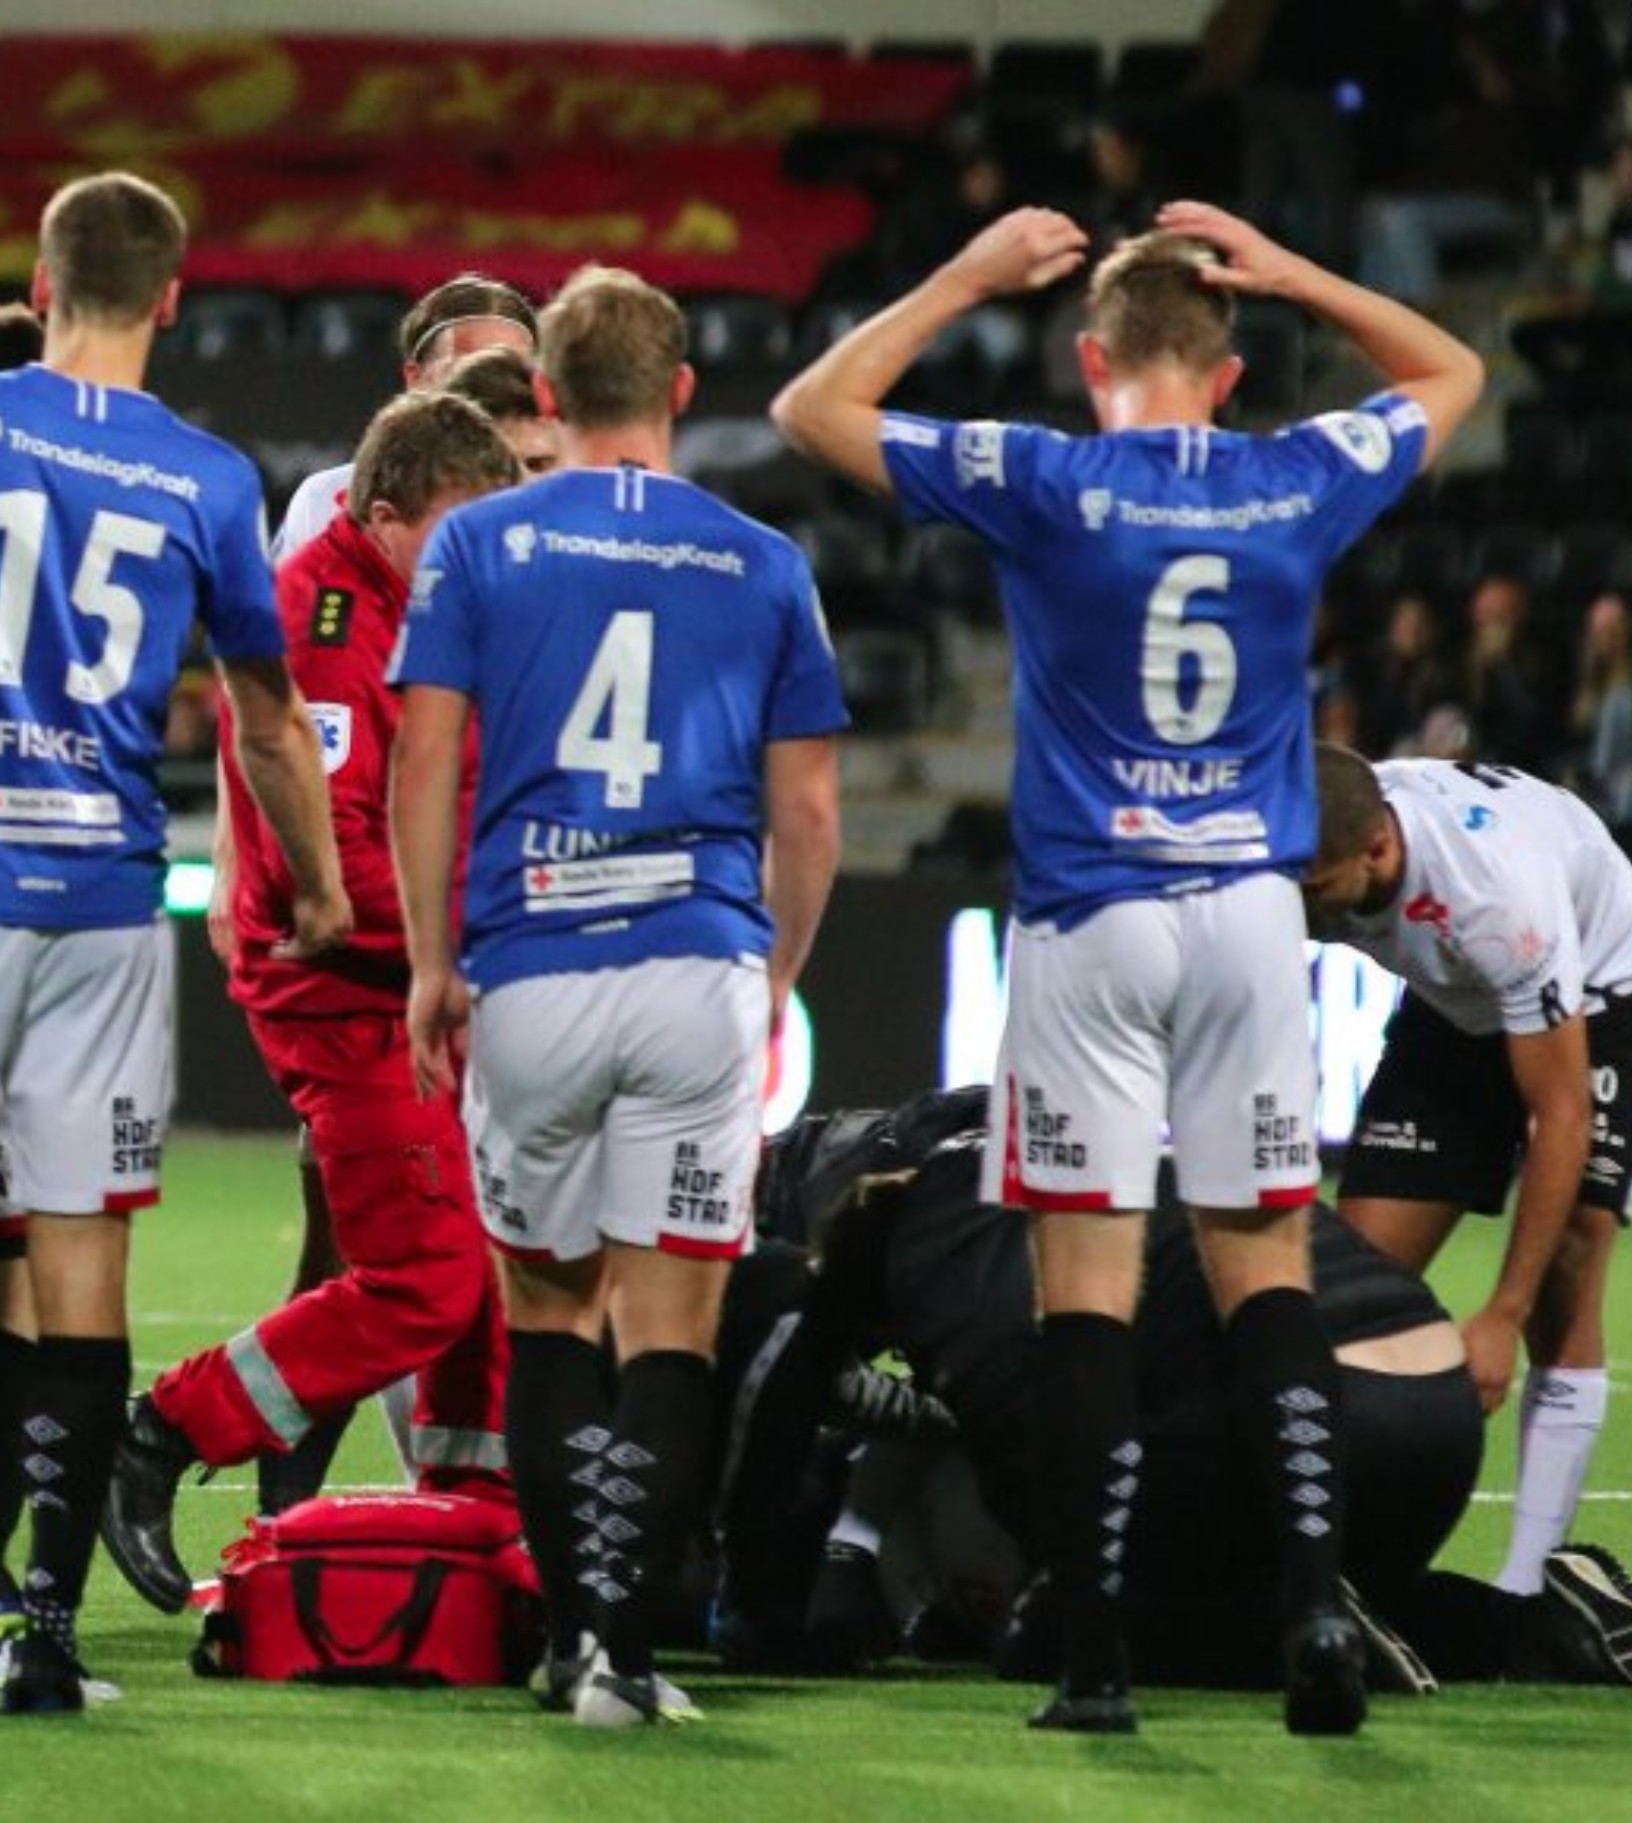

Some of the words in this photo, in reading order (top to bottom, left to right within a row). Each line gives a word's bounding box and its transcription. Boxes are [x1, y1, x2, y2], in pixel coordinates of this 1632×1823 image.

[1142, 554, 1237, 744] 6
[555, 610, 662, 808] 4
[1112, 758, 1246, 798] VINJE
[113, 1119, 156, 1146] HOF
[1027, 1111, 1072, 1137] HOF
[1254, 1115, 1300, 1142] HOF
[113, 1146, 162, 1174] STA
[1027, 1139, 1086, 1170] STAD
[672, 1167, 723, 1194] HOF
